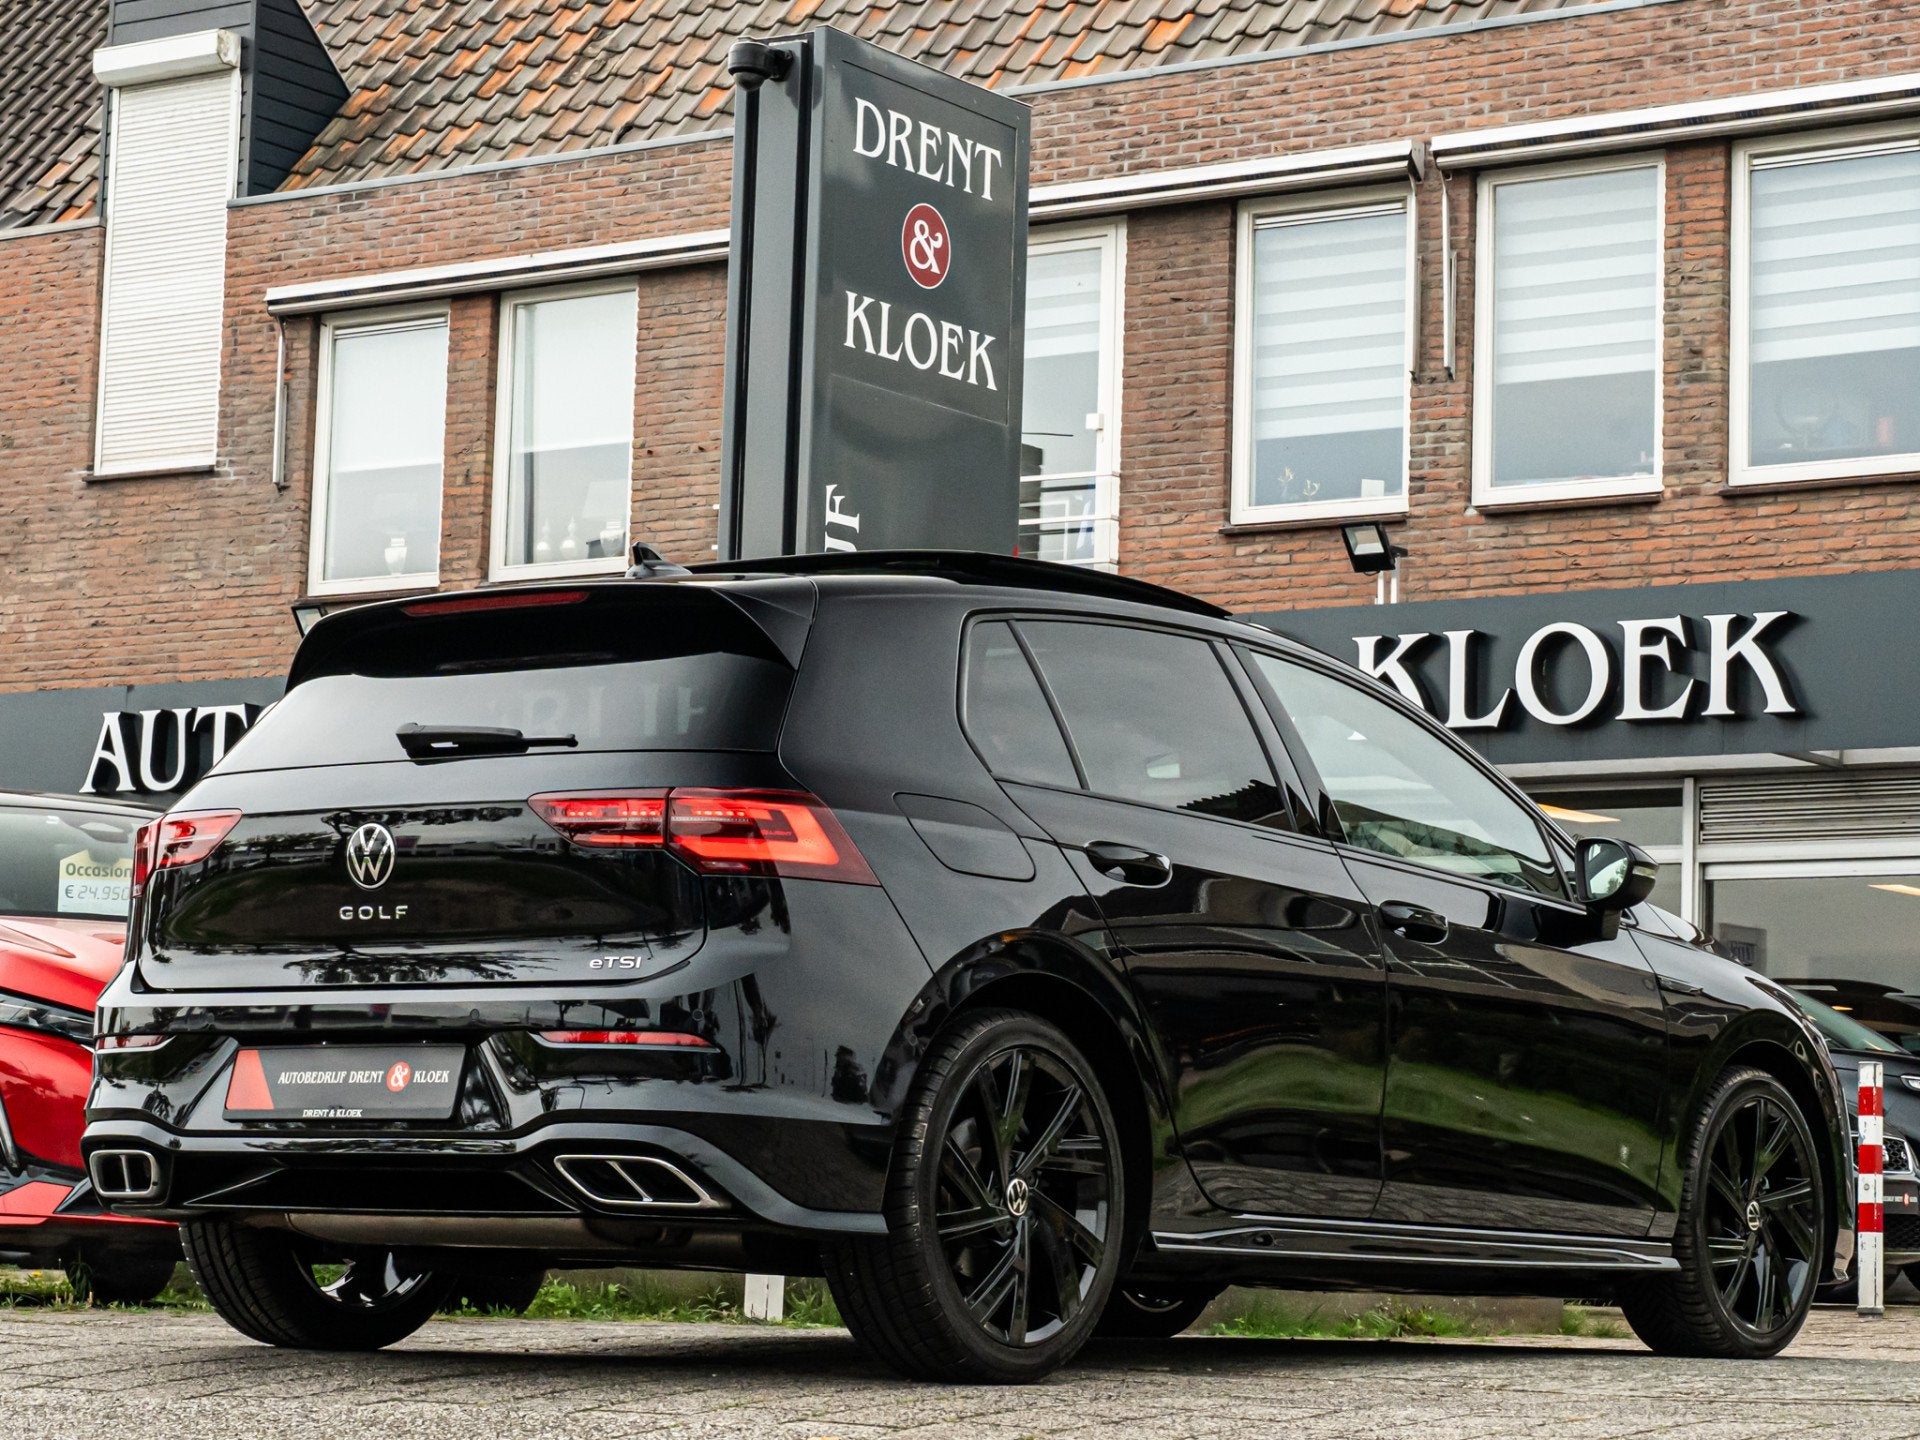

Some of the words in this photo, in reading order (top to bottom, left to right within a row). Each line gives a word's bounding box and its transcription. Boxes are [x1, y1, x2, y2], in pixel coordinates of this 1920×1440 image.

[853, 97, 1003, 202] DRENT
[909, 218, 944, 275] &
[843, 290, 999, 391] KLOEK
[1351, 610, 1798, 729] KLOEK
[79, 700, 277, 792] AUT
[65, 862, 132, 878] Occasion
[338, 905, 409, 921] GOLF
[588, 956, 642, 970] eTSI
[277, 1071, 347, 1085] AUTOBEDRIJF
[348, 1070, 385, 1084] DRENT
[390, 1064, 409, 1088] &
[413, 1070, 450, 1083] KLOEK
[302, 1108, 329, 1118] DRENT
[336, 1108, 363, 1118] KLOEK
